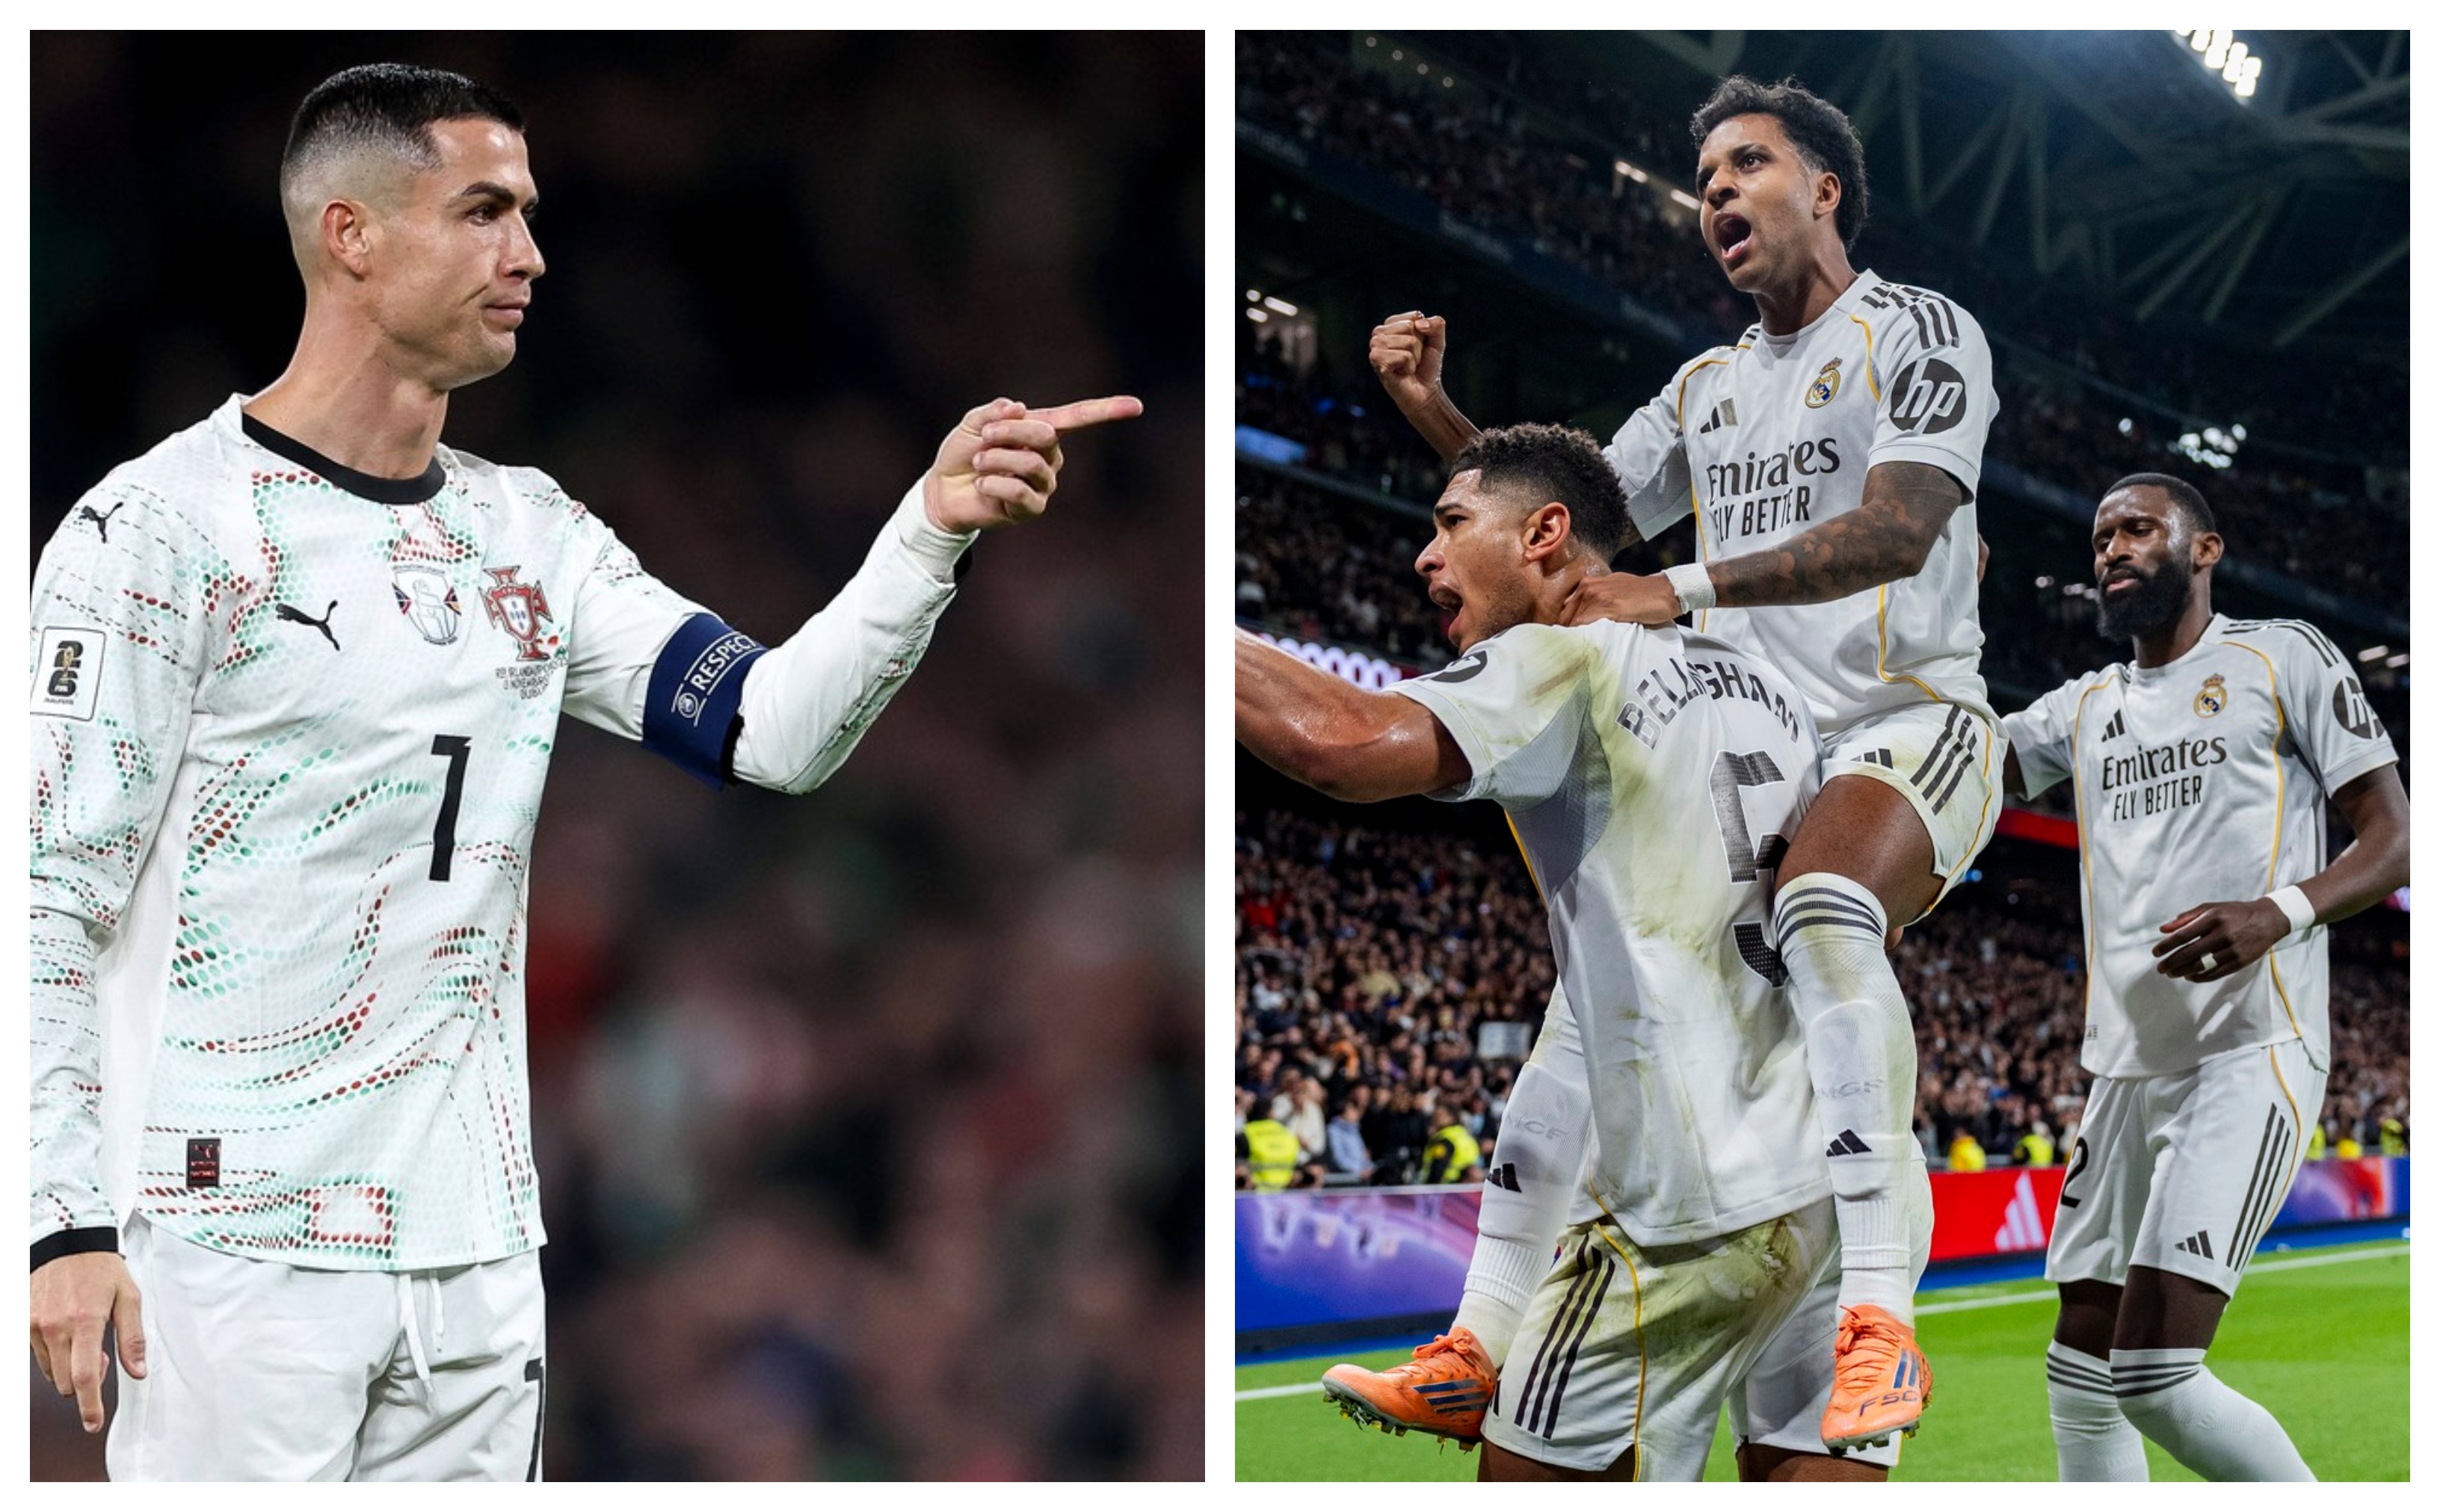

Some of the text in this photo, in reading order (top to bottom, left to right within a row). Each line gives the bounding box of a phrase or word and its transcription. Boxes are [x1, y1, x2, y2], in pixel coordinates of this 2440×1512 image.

[1891, 358, 1965, 433] hp
[1741, 486, 1811, 537] BETTER
[2102, 736, 2227, 791] Emirates
[2113, 775, 2202, 821] FLY BETTER
[1710, 750, 1789, 988] 5
[2060, 1137, 2089, 1209] 2
